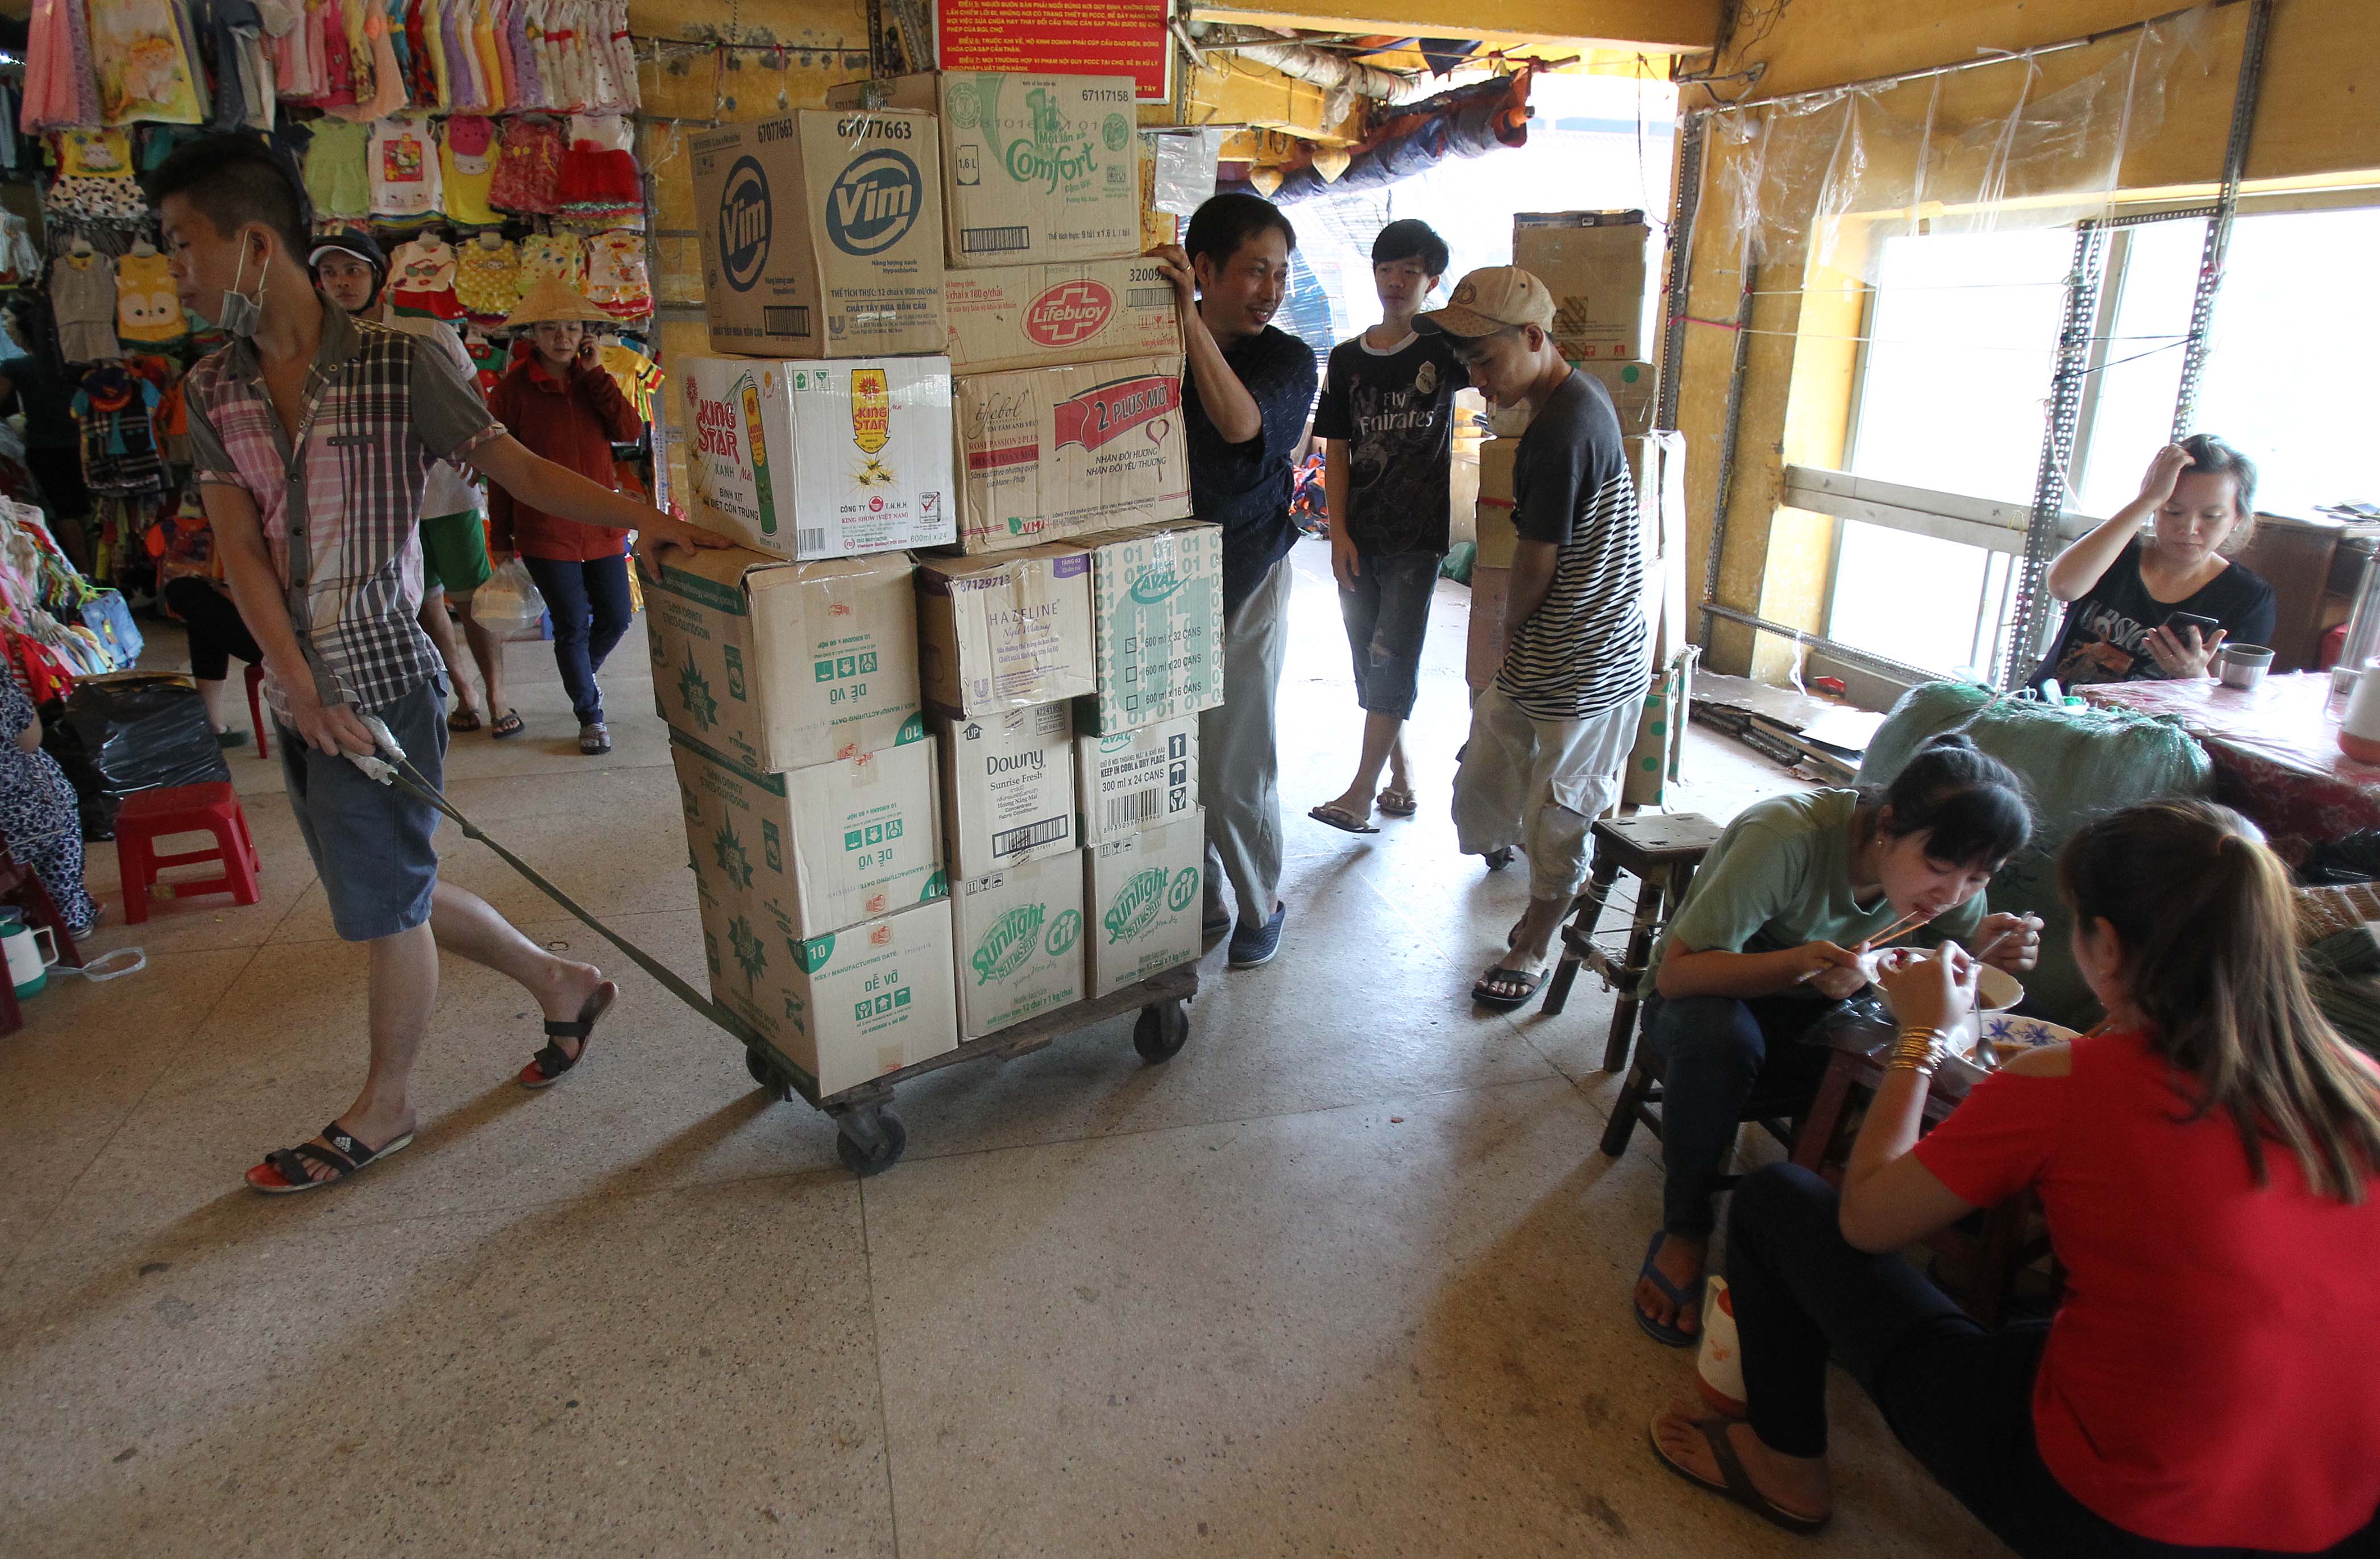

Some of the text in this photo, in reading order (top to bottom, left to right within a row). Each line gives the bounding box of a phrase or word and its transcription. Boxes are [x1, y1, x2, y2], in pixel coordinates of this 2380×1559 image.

[1082, 90, 1128, 102] 67117158
[758, 118, 793, 143] 67077663
[837, 119, 912, 140] 67077663
[958, 159, 977, 170] 1,6 L
[1006, 139, 1098, 196] Comfort
[836, 181, 912, 226] Vim
[722, 198, 766, 256] Vim
[844, 288, 858, 297] TÍCH
[887, 288, 899, 296] chai
[950, 290, 964, 300] chai
[970, 289, 982, 298] 180
[983, 288, 1003, 300] g/chai
[1033, 305, 1106, 323] Lifebuoy
[858, 408, 887, 418] KING
[1094, 392, 1144, 433] 2 PLUS
[854, 414, 888, 432] STAR
[696, 413, 740, 464] STAR
[990, 437, 1017, 448] PASSION
[1023, 434, 1039, 443] PLUS
[1096, 447, 1158, 464] NHÂN ĐÔI HƯƠNG
[715, 463, 734, 479] XANH
[1086, 456, 1166, 476] NHÂN ĐÔI YÊU THƯƠNG
[720, 487, 743, 502] BÌNH XỊT
[738, 505, 759, 520] TRÙNG
[1023, 519, 1045, 533] VMJ
[910, 534, 931, 543] 600ml
[938, 531, 946, 540] 24
[961, 574, 1011, 592] 67129713
[1139, 570, 1178, 592] AVAL
[989, 601, 1058, 626] HAZELINE
[1145, 626, 1201, 647] 600 ml 32 CANS
[1145, 654, 1201, 676] 600 ml 20 CANS
[829, 683, 867, 705] DỄ VỠ
[1146, 681, 1202, 704] 600 ml 16 CANS
[829, 717, 848, 726] DATE:
[849, 706, 900, 721] MANUFACTURING
[905, 725, 919, 741] 10
[967, 727, 979, 739] UP
[986, 749, 1044, 775] Downy
[1100, 767, 1113, 778] KEEP
[1114, 765, 1120, 774] IN
[1120, 762, 1134, 774] COOL
[1139, 758, 1150, 769] DRY
[1150, 754, 1165, 765] PLACE
[990, 776, 1020, 791] Sunrise
[1022, 771, 1042, 783] Fresh
[1102, 781, 1115, 792] 300
[1117, 778, 1126, 789] ml
[1134, 774, 1142, 784] 24
[1144, 768, 1164, 782] CANS
[999, 805, 1039, 820] Fabric Conditioner
[1005, 802, 1032, 813] Concentrate
[858, 848, 892, 871] DỄ VỠ
[858, 866, 924, 889] MANUFACTURING DATE:
[1170, 871, 1196, 908] Cif
[1104, 867, 1169, 945] Sunlight
[810, 944, 826, 960] 10
[973, 903, 1046, 986] Sunlight
[814, 950, 899, 982] NSX MANUFACTURING DATE:
[865, 969, 899, 993] DỄ VỠ
[1031, 998, 1042, 1009] chai
